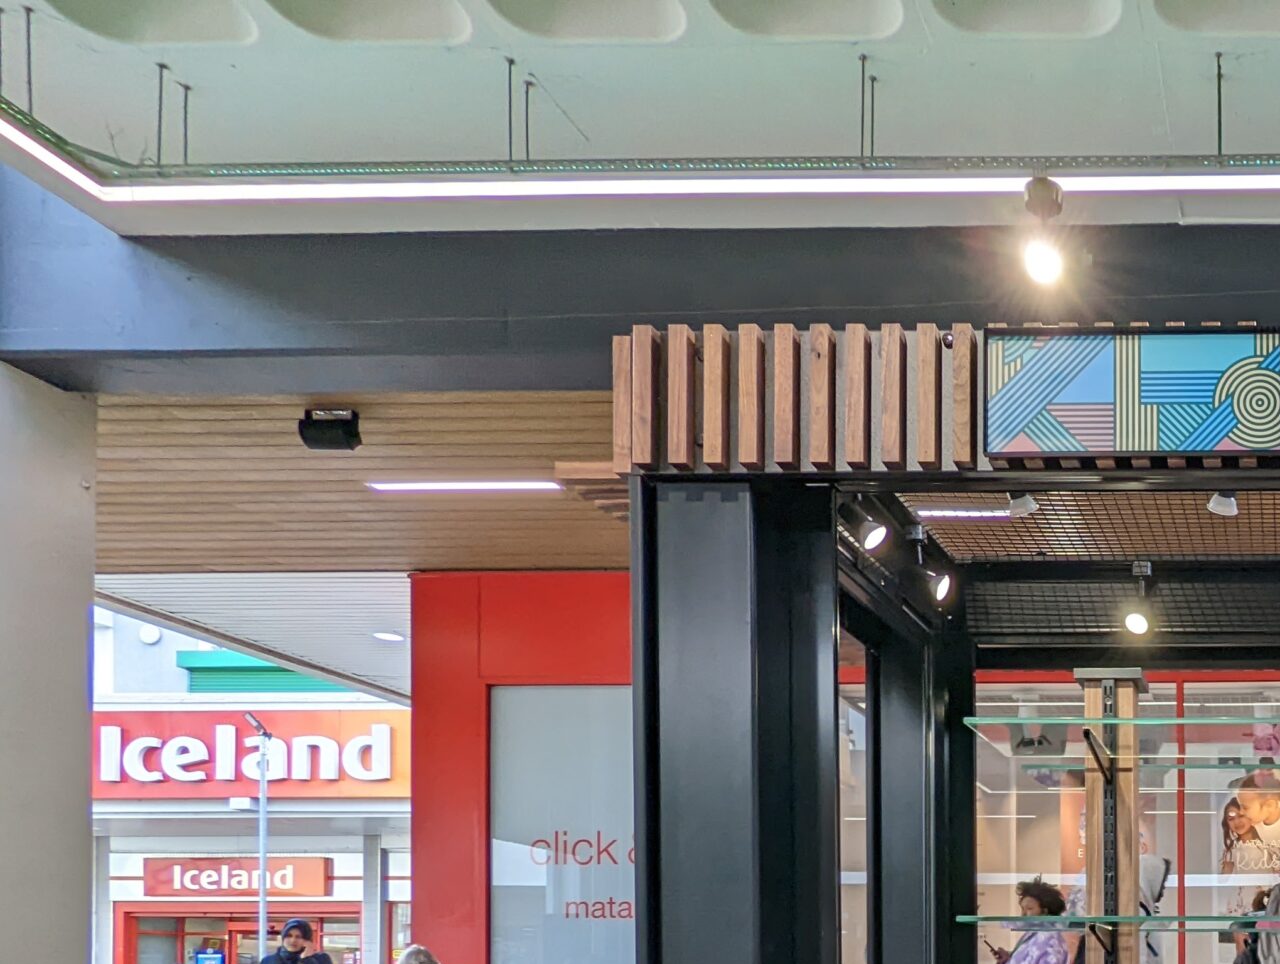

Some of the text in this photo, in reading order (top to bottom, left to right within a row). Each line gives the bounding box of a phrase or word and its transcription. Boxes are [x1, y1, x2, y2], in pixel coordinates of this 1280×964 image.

[100, 723, 392, 783] Iceland
[530, 830, 619, 866] click
[173, 864, 294, 890] Iceland
